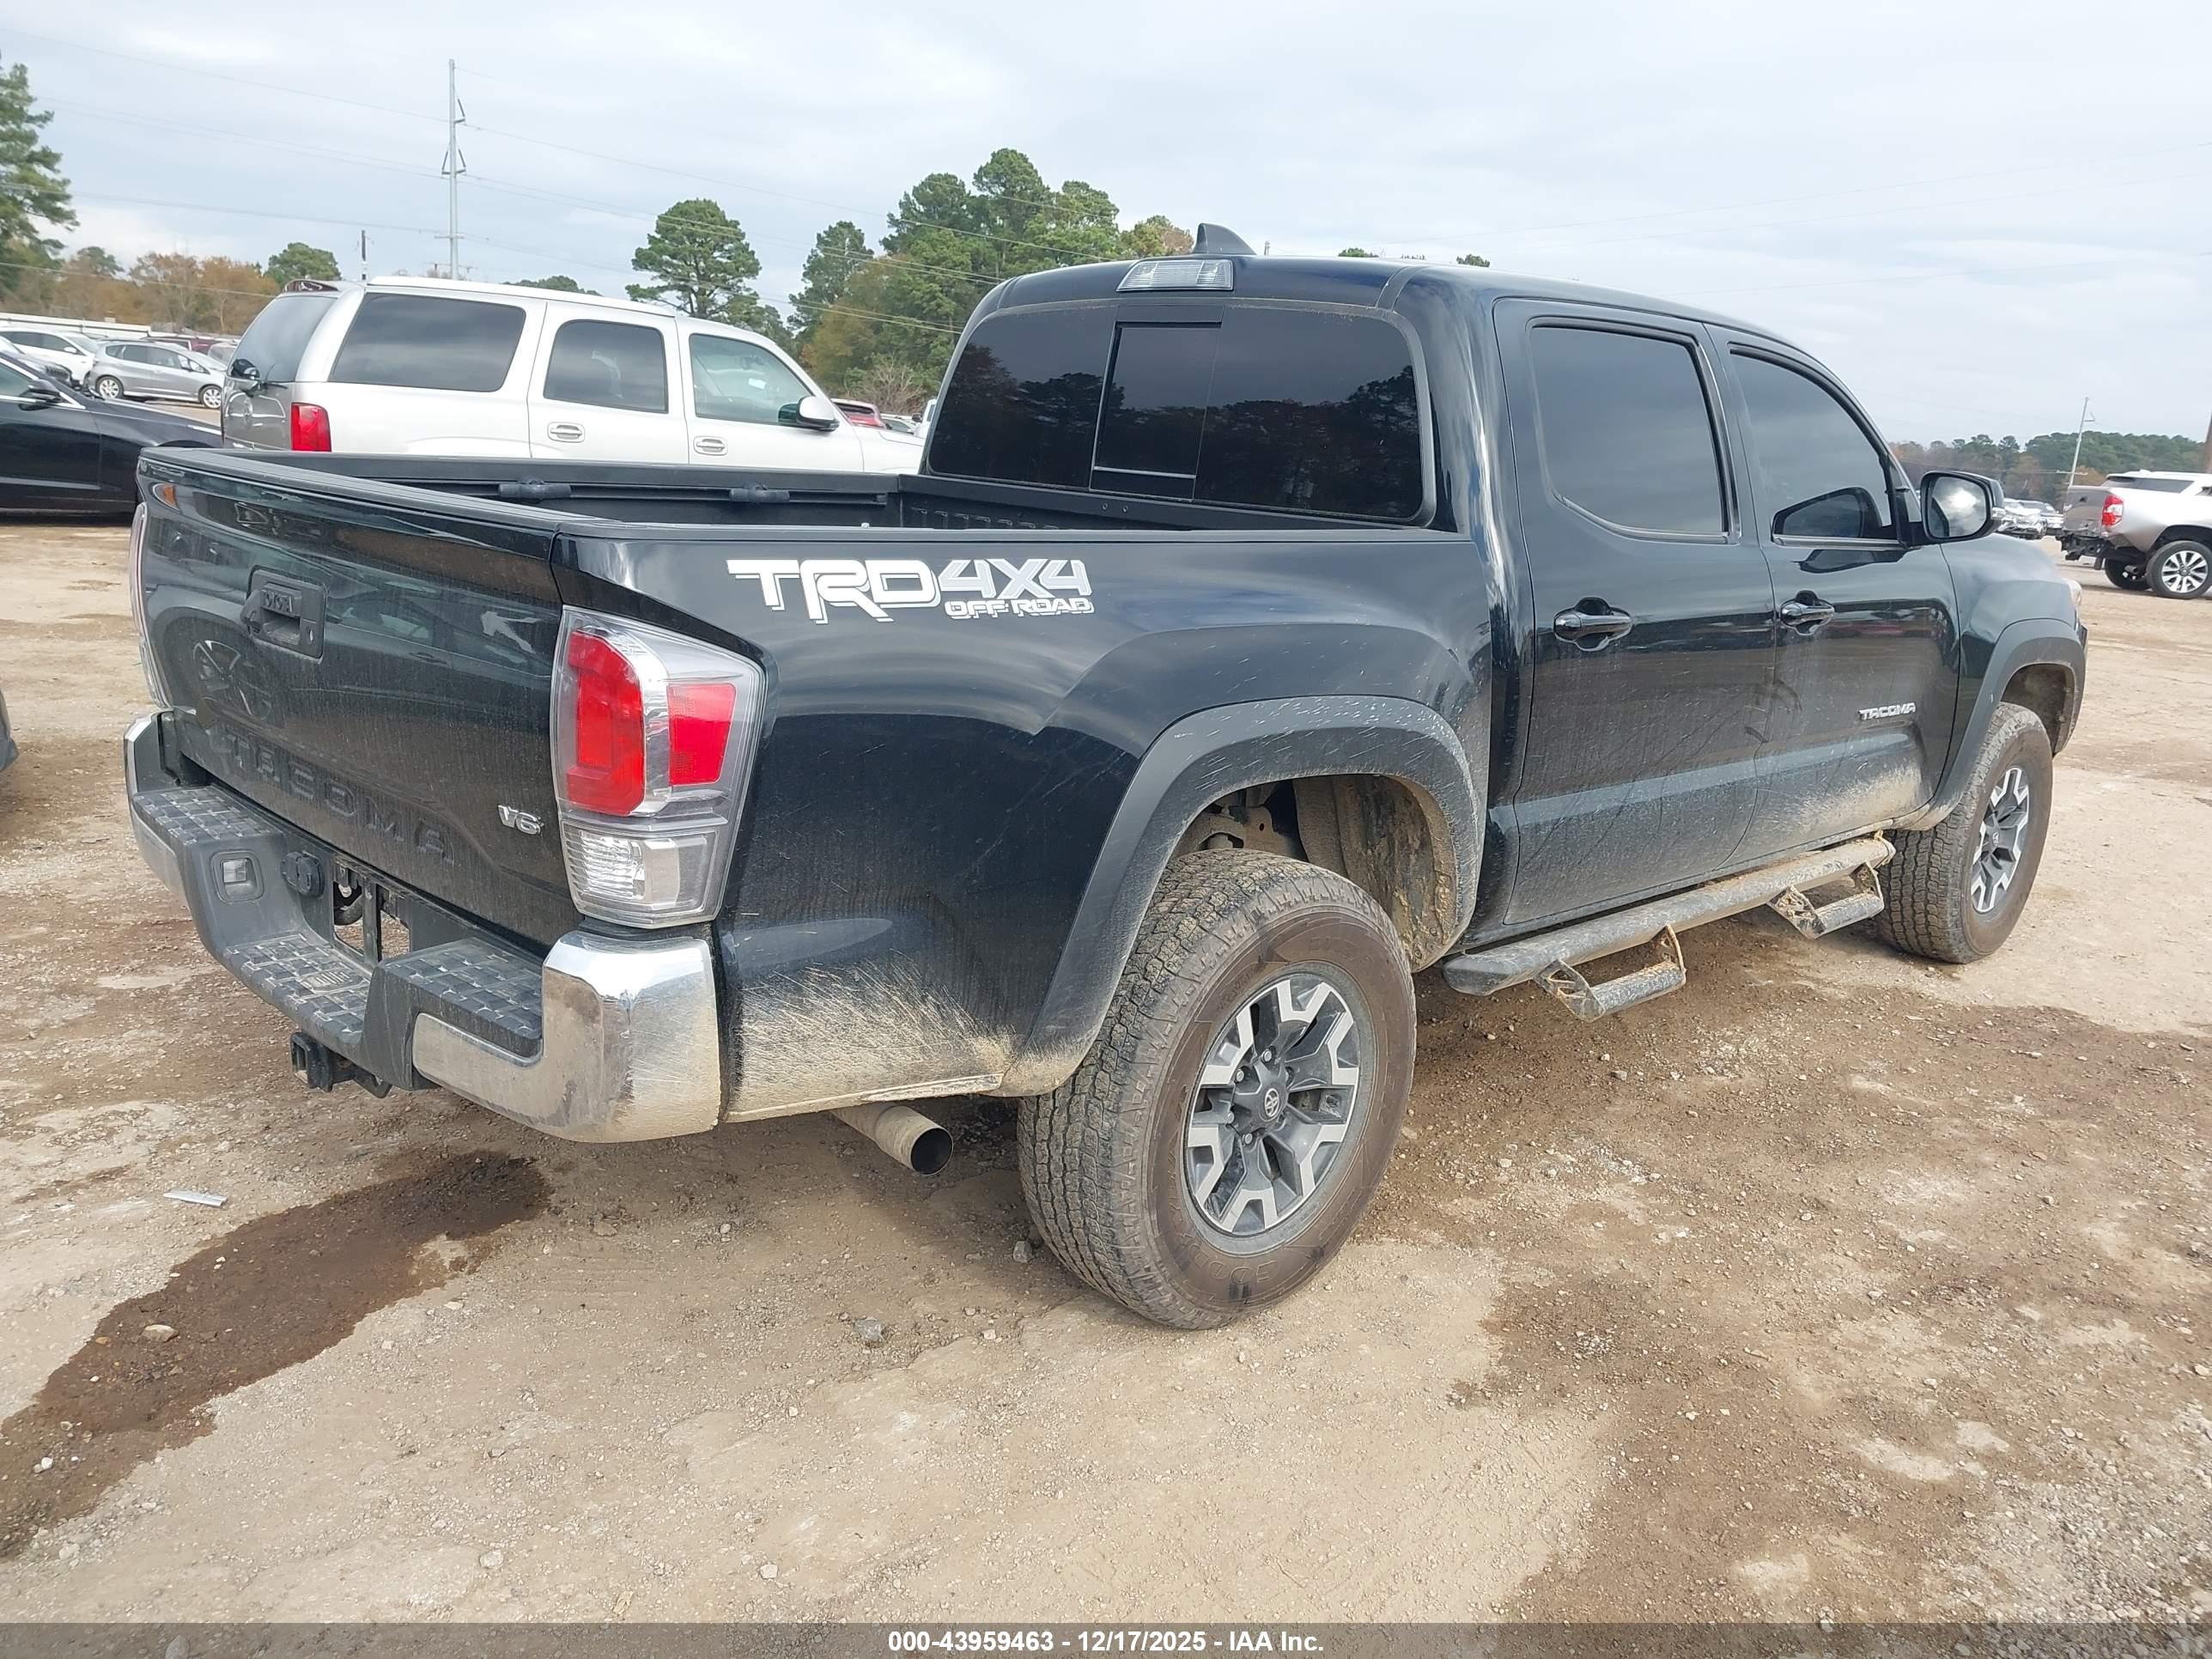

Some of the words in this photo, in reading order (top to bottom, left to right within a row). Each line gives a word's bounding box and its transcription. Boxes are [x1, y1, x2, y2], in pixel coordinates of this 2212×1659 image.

[726, 559, 941, 624] TRD
[939, 558, 1092, 599] 4X4
[945, 599, 1011, 619] OFF
[1011, 598, 1095, 617] ROAD
[1858, 702, 1916, 720] TACOMA
[498, 805, 542, 836] V6
